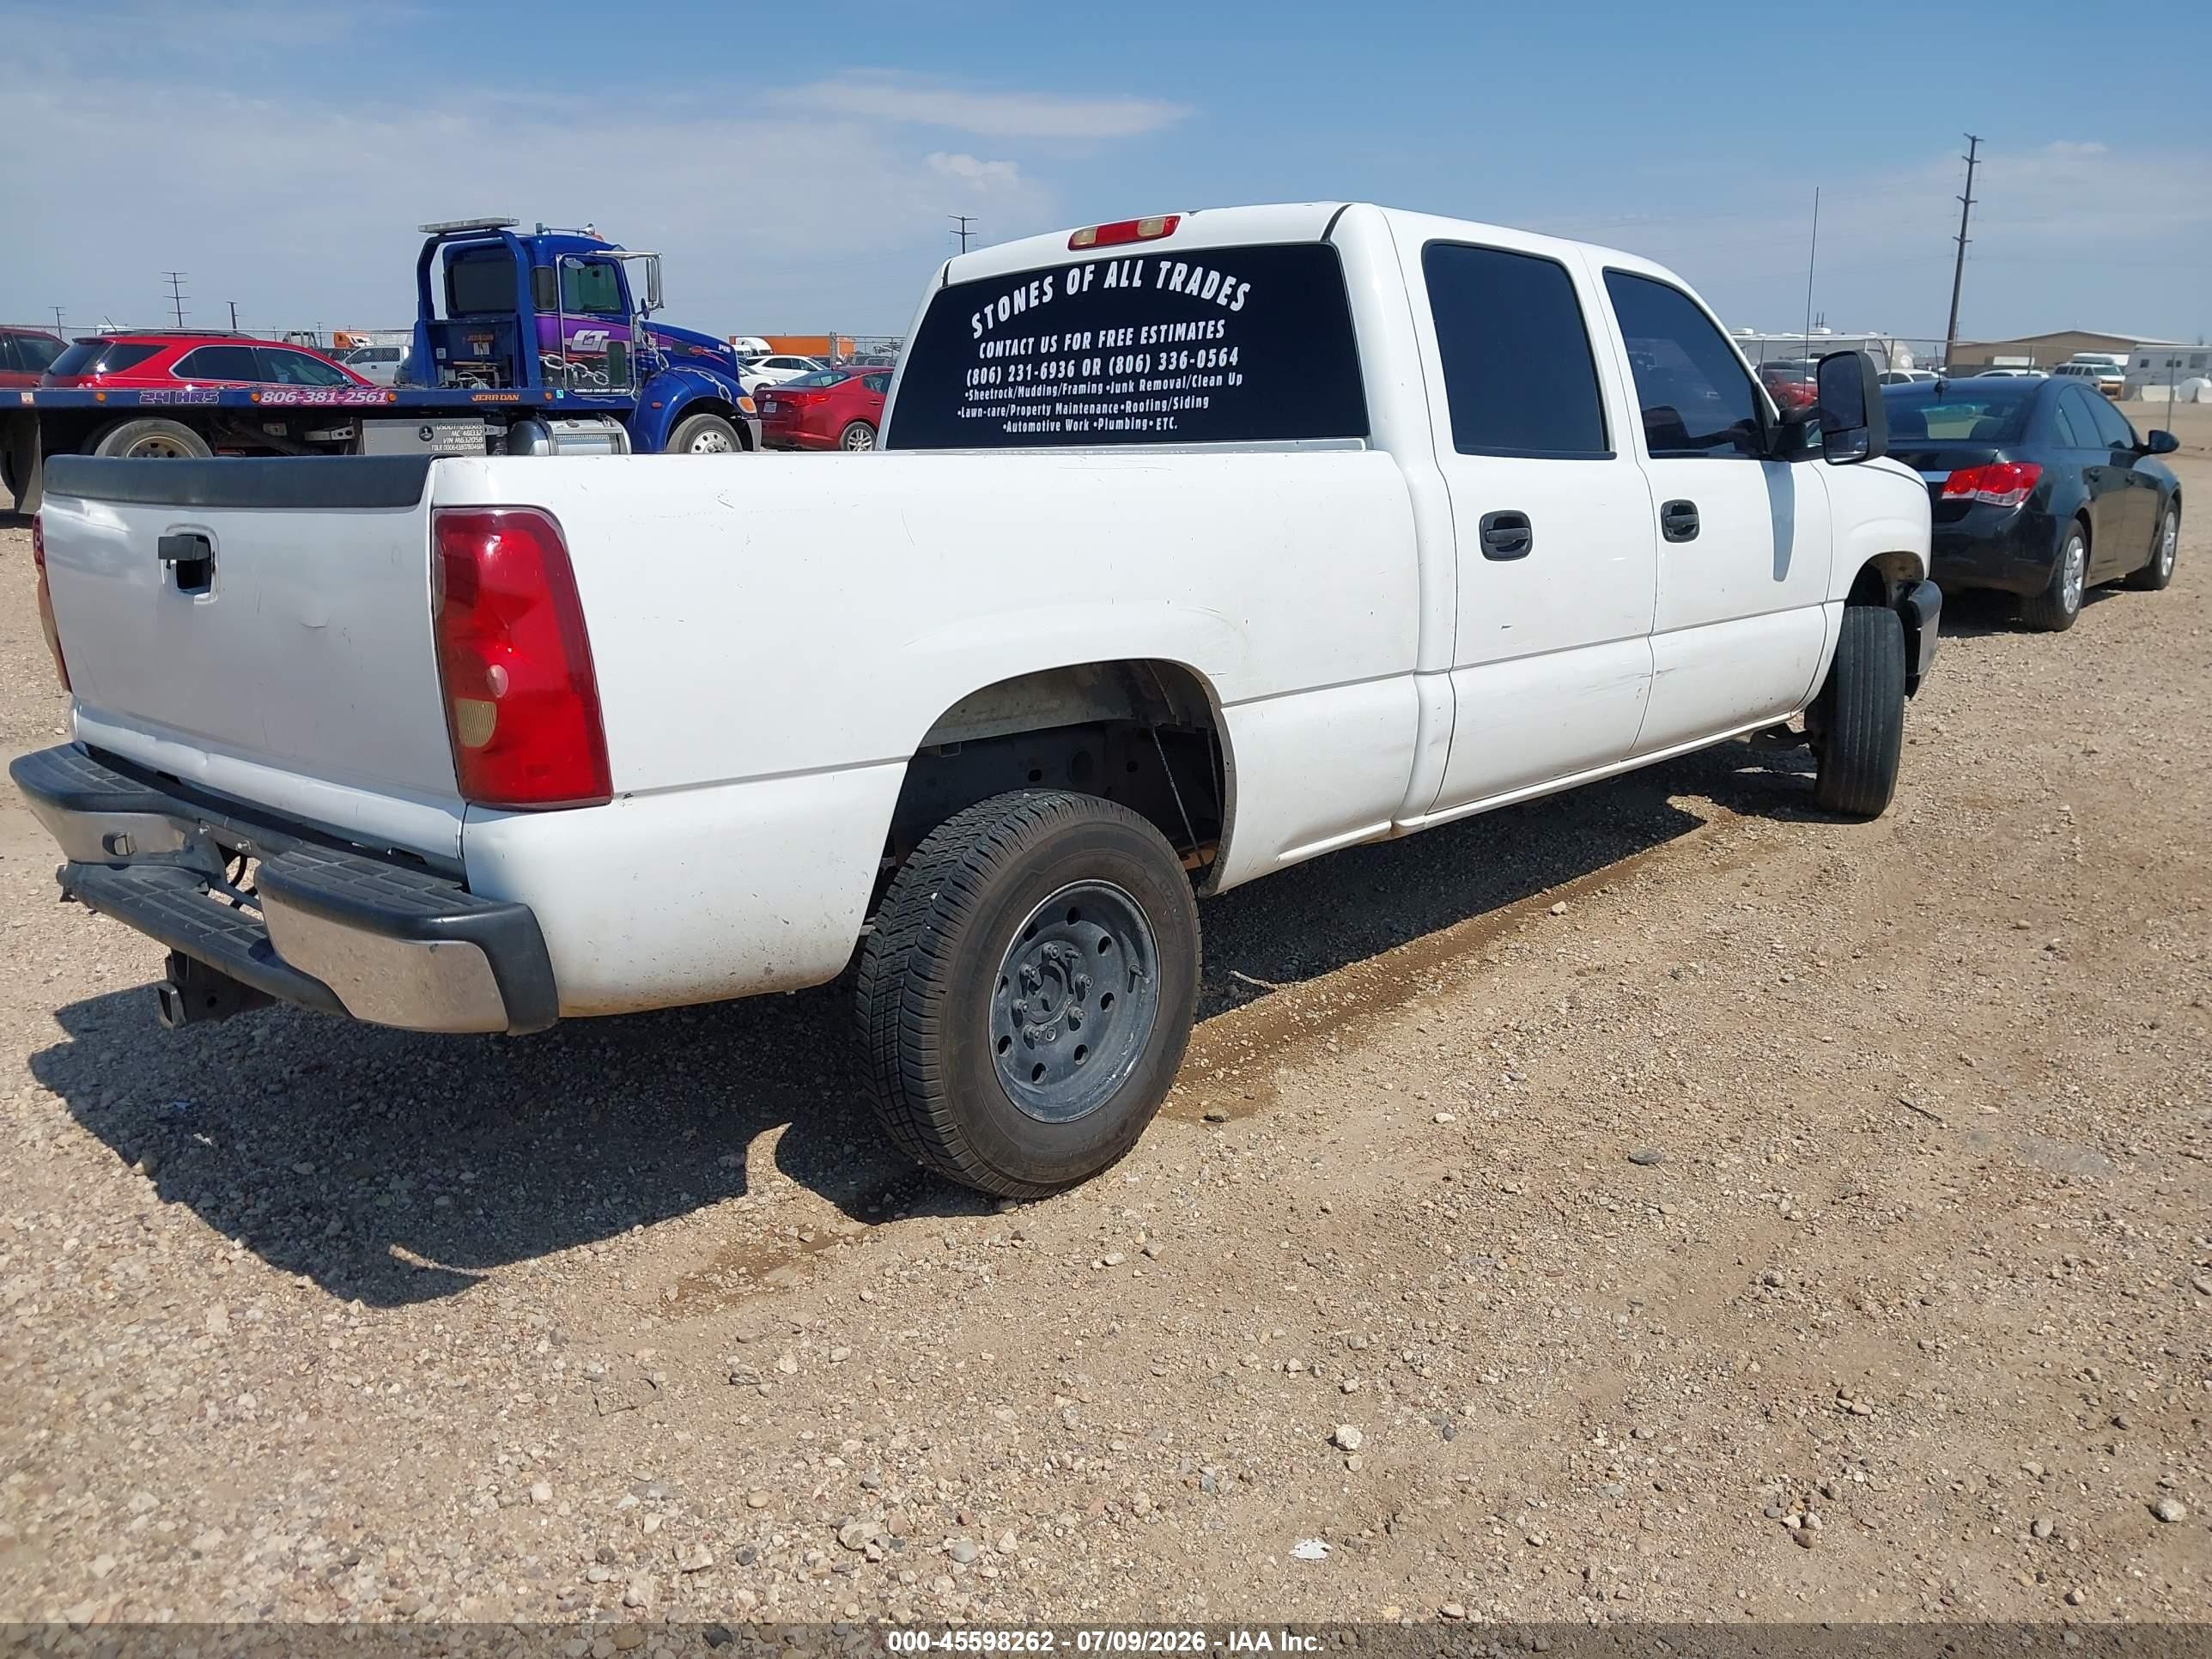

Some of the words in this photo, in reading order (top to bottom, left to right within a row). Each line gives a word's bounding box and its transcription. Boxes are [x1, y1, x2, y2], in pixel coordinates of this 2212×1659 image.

[971, 275, 1054, 339] STONES
[1066, 264, 1096, 295] OF
[1103, 259, 1145, 289] ALL
[1156, 260, 1252, 312] TRADES
[979, 337, 1035, 359] CONTACT
[1040, 335, 1058, 353] US
[1064, 331, 1092, 351] FOR
[1097, 327, 1134, 349] FREE
[1139, 319, 1225, 344] ESTIMATES
[966, 366, 1002, 387] (806)
[1008, 360, 1075, 382] 231-6936
[1082, 357, 1102, 376] OR
[1109, 353, 1152, 376] (806)
[1158, 346, 1239, 371] 336-0564
[1139, 373, 1223, 392] Removal/Clean
[1228, 372, 1243, 386] Up
[139, 391, 171, 404] 24
[259, 390, 387, 405] 806-381-2561
[1065, 418, 1090, 431] Work
[1156, 416, 1178, 430] ETC.
